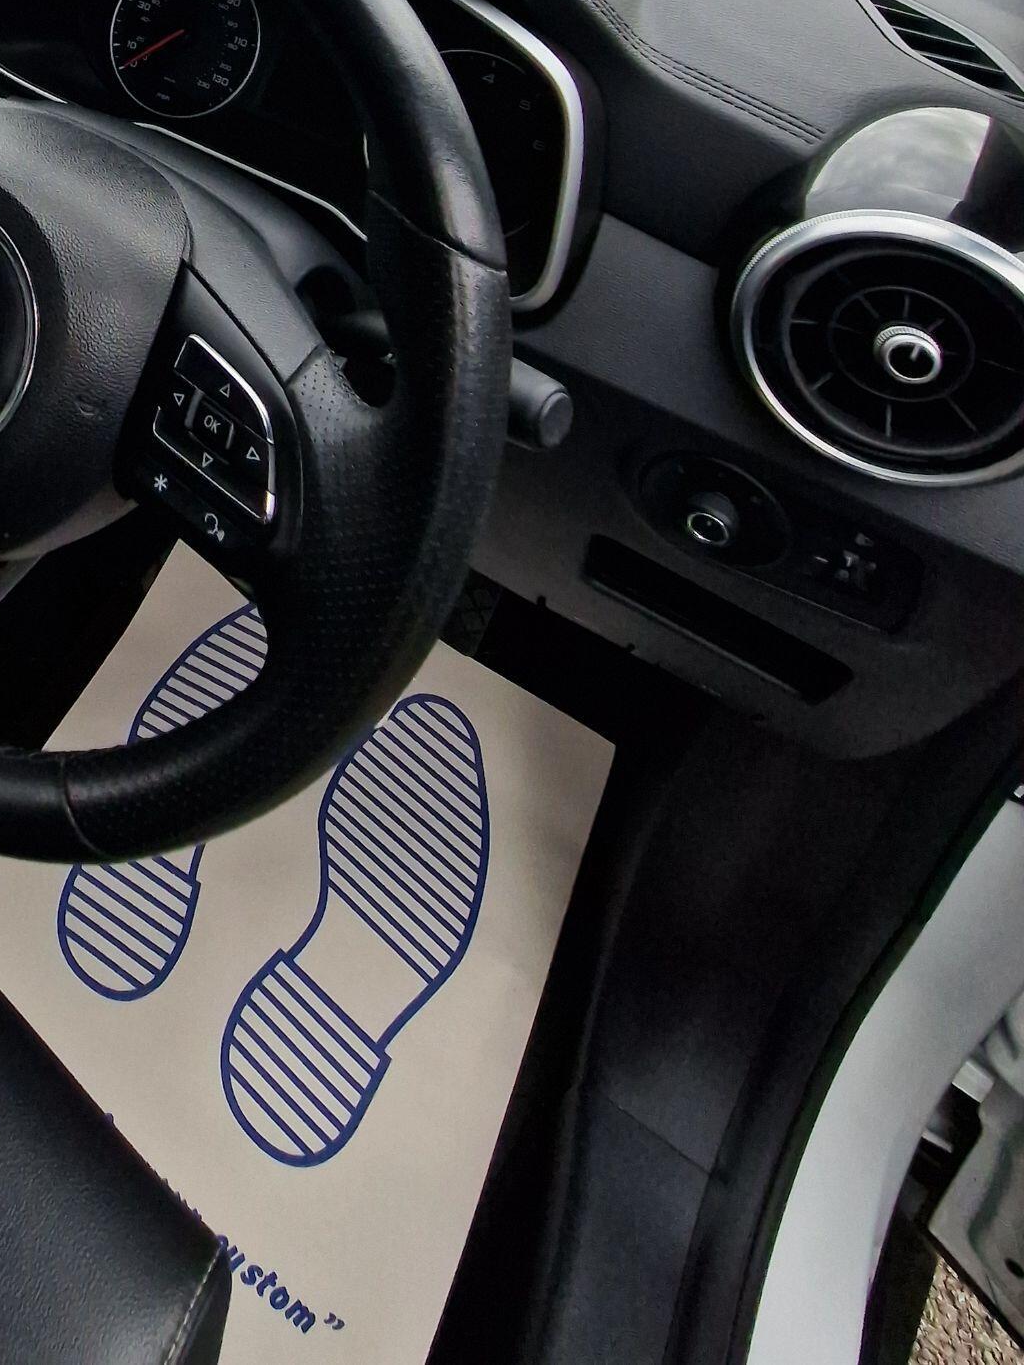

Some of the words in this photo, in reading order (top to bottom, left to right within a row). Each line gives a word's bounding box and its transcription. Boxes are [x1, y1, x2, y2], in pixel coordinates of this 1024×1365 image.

[137, 0, 151, 12] 30
[126, 40, 137, 50] 10
[233, 36, 248, 48] 110
[212, 73, 229, 86] 130
[482, 74, 495, 84] 4
[204, 415, 221, 435] OK
